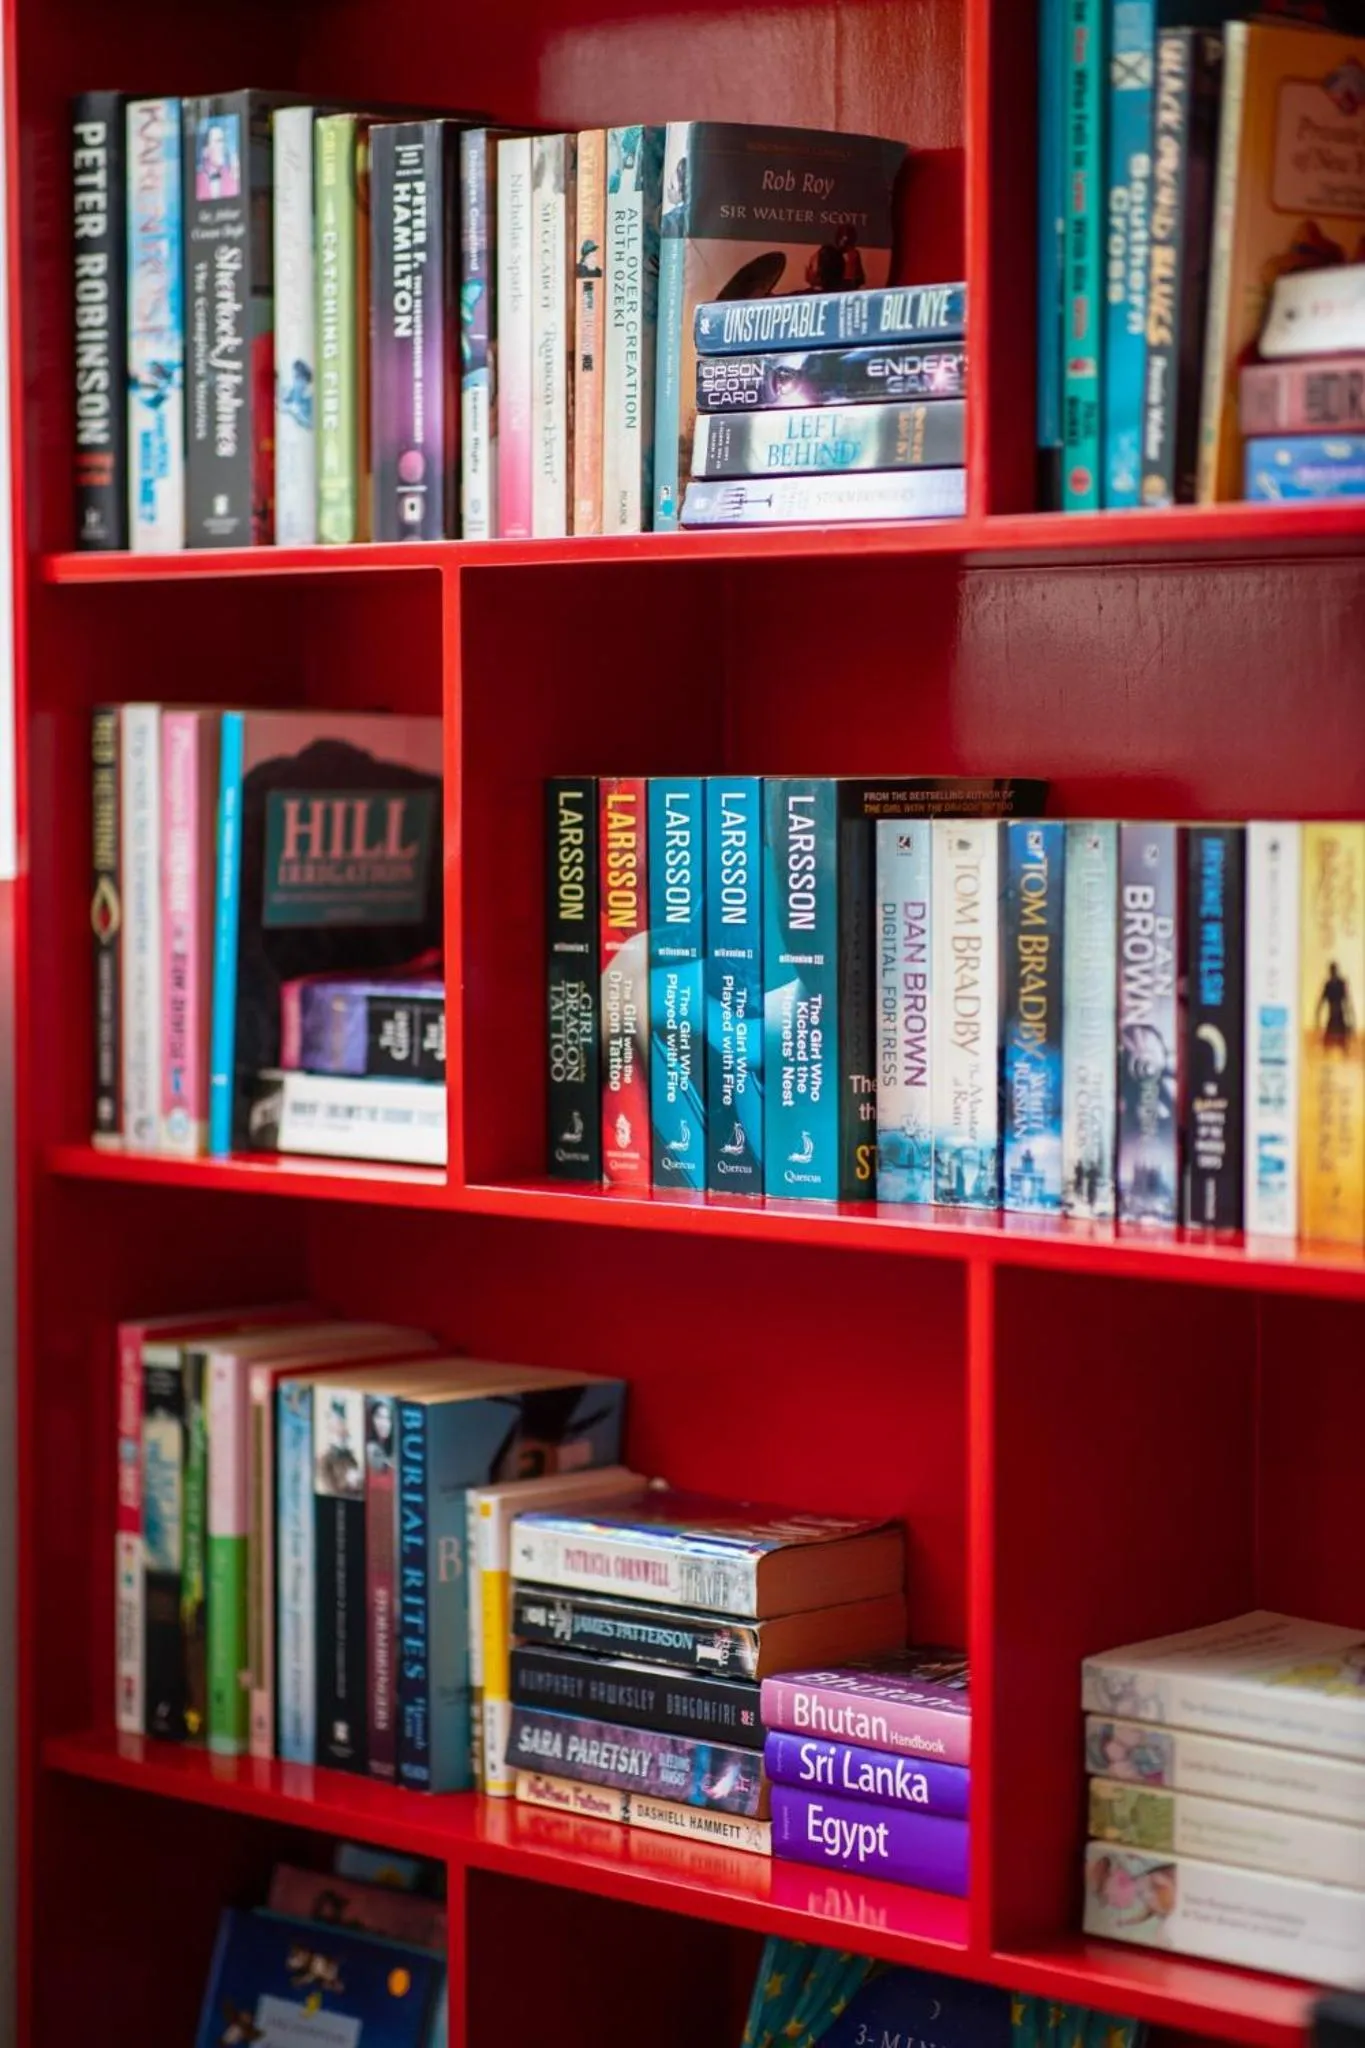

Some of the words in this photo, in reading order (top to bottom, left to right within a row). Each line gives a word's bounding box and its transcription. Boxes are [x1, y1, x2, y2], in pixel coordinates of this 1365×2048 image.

[74, 121, 107, 239] PETER
[469, 150, 479, 205] Douglas
[762, 169, 796, 191] Rob
[803, 173, 835, 199] Roy
[412, 180, 427, 245] PETER
[510, 173, 524, 248] Nicholas
[613, 210, 626, 263] RUTH
[626, 208, 639, 248] ALL
[720, 205, 747, 219] SIR
[753, 206, 814, 222] WALTER
[820, 211, 868, 226] SCOTT
[393, 182, 413, 338] HAMILTON
[413, 252, 427, 268] F.
[1108, 186, 1132, 304] Cross
[1126, 153, 1152, 335] Southern
[213, 245, 243, 353] Sherlock
[323, 231, 338, 359] CATCHING
[506, 254, 524, 314] Sparks
[612, 269, 626, 328] OZEKI
[626, 255, 639, 316] OVER
[723, 300, 828, 343] UNSTOPPABLE
[880, 292, 915, 331] BILL
[917, 290, 952, 328] NYE
[75, 252, 110, 445] ROBINSON
[702, 361, 764, 378] ORSON
[209, 343, 244, 458] Holmes
[323, 371, 339, 430] FIRE
[625, 321, 639, 429] CREATION
[702, 377, 763, 392] SCOTT
[708, 390, 758, 405] CARD
[886, 374, 960, 394] GAME
[787, 414, 843, 440] LEFT
[767, 442, 858, 468] BEHIND
[864, 792, 890, 802] FROM
[892, 792, 907, 801] THE
[909, 791, 964, 801] BESTSELLING
[864, 803, 881, 813] THE
[284, 798, 419, 859] HILL
[558, 791, 585, 920] LARSSON
[606, 793, 638, 928] LARSSON
[665, 792, 691, 924] LARSSON
[720, 792, 747, 924] LARSSON
[788, 796, 815, 930] LARSSON
[953, 861, 981, 925] TOM
[1020, 861, 1048, 926] TOM
[881, 902, 898, 978] DIGITAL
[903, 902, 927, 963] DAN
[1122, 884, 1156, 1026] BROWN
[1153, 916, 1175, 997] DAN
[604, 971, 623, 1036] Dragon
[624, 980, 633, 999] The
[663, 973, 678, 1029] Played
[679, 986, 691, 1016] The
[719, 975, 734, 1031] Played
[735, 987, 748, 1018] The
[809, 994, 822, 1025] The
[950, 935, 983, 1056] BRADBY
[1014, 934, 1050, 1058] BRADBY
[550, 981, 567, 1083] TATTOO
[565, 982, 581, 1082] DRAGON
[579, 993, 593, 1044] GIRL
[623, 1004, 638, 1033] Girl
[679, 1020, 691, 1049] Girl
[735, 1022, 748, 1053] Girl
[795, 1001, 809, 1060] Kicked
[810, 1029, 822, 1060] Girl
[881, 986, 898, 1088] FORTRESS
[903, 971, 927, 1087] BROWN
[608, 1039, 623, 1091] Tattoo
[624, 1037, 634, 1063] with
[624, 1065, 634, 1084] the
[665, 1033, 678, 1066] with
[679, 1054, 691, 1091] Who
[721, 1035, 734, 1070] with
[735, 1056, 748, 1093] Who
[666, 1070, 678, 1103] Fire
[721, 1073, 734, 1106] Fire
[781, 1066, 795, 1107] Nest
[796, 1066, 808, 1094] the
[809, 1063, 822, 1102] Who
[555, 1149, 590, 1165] Quercus
[662, 1157, 696, 1171] Quercus
[717, 1160, 752, 1174] Quercus
[784, 1169, 822, 1184] Quercus
[401, 1407, 425, 1554] BURIAL
[563, 1547, 611, 1578] PATRICIA
[614, 1556, 670, 1587] CORNWELL
[401, 1567, 426, 1681] RITES
[573, 1614, 615, 1638] JAMES
[616, 1622, 694, 1650] PATTERSON
[589, 1680, 655, 1711] HAWKSLEY
[666, 1693, 736, 1726] DRAGONFIRE
[794, 1672, 953, 1706] Bhutan
[793, 1693, 887, 1743] Bhutan
[889, 1731, 946, 1754] Handbook
[518, 1725, 562, 1759] SARA
[566, 1735, 652, 1777] PARETSKY
[799, 1743, 836, 1785] Sri
[843, 1751, 929, 1804] Lanka
[637, 1804, 686, 1827] DASHIELL
[690, 1815, 740, 1839] HAMMETT
[807, 1804, 889, 1862] Egypt
